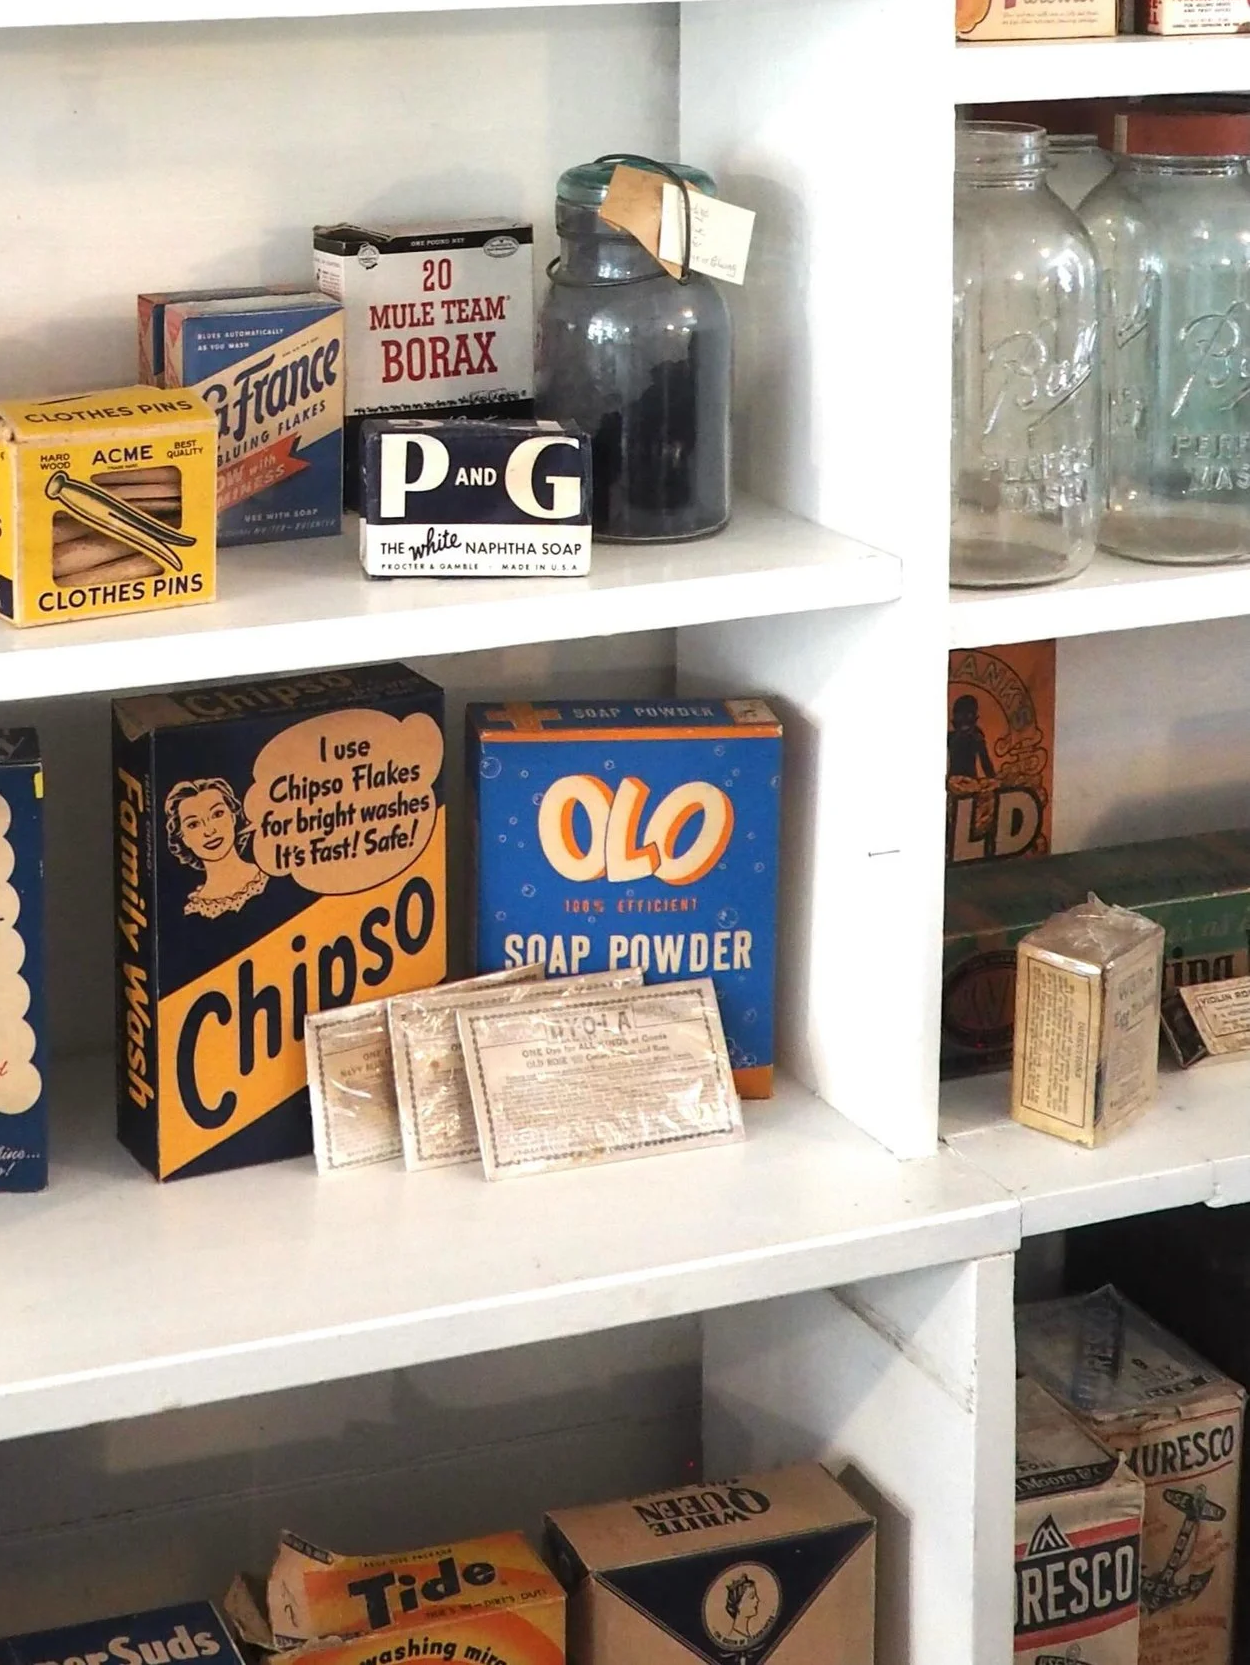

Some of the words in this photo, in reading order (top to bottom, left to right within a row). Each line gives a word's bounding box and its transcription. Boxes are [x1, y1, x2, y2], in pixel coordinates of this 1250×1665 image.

[422, 259, 452, 291] 20
[369, 303, 434, 330] MULE
[444, 296, 507, 324] TEAM
[381, 332, 498, 383] BORAX
[92, 445, 153, 465] ACME
[380, 434, 450, 519] P
[455, 467, 496, 486] AND
[505, 435, 581, 519] G
[381, 542, 405, 555] THE
[409, 527, 462, 561] white
[466, 542, 537, 555] NAPHTHA
[542, 542, 582, 555] SOAP
[38, 582, 144, 613] CLOTHES
[153, 574, 202, 597] PINS
[319, 736, 327, 762] I
[335, 737, 370, 761] use
[269, 772, 343, 804] Chipso
[352, 766, 420, 796] Flakes
[262, 811, 293, 838] for
[296, 805, 357, 839] bright
[361, 796, 430, 827] washes
[538, 774, 734, 886] OLO
[276, 841, 305, 869] It's
[311, 829, 359, 865] Fast!
[364, 820, 418, 853] Safe!
[505, 934, 590, 974] SOAP
[609, 930, 751, 974] POWDER
[177, 877, 434, 1130] Chipso
[349, 1557, 497, 1630] Tide
